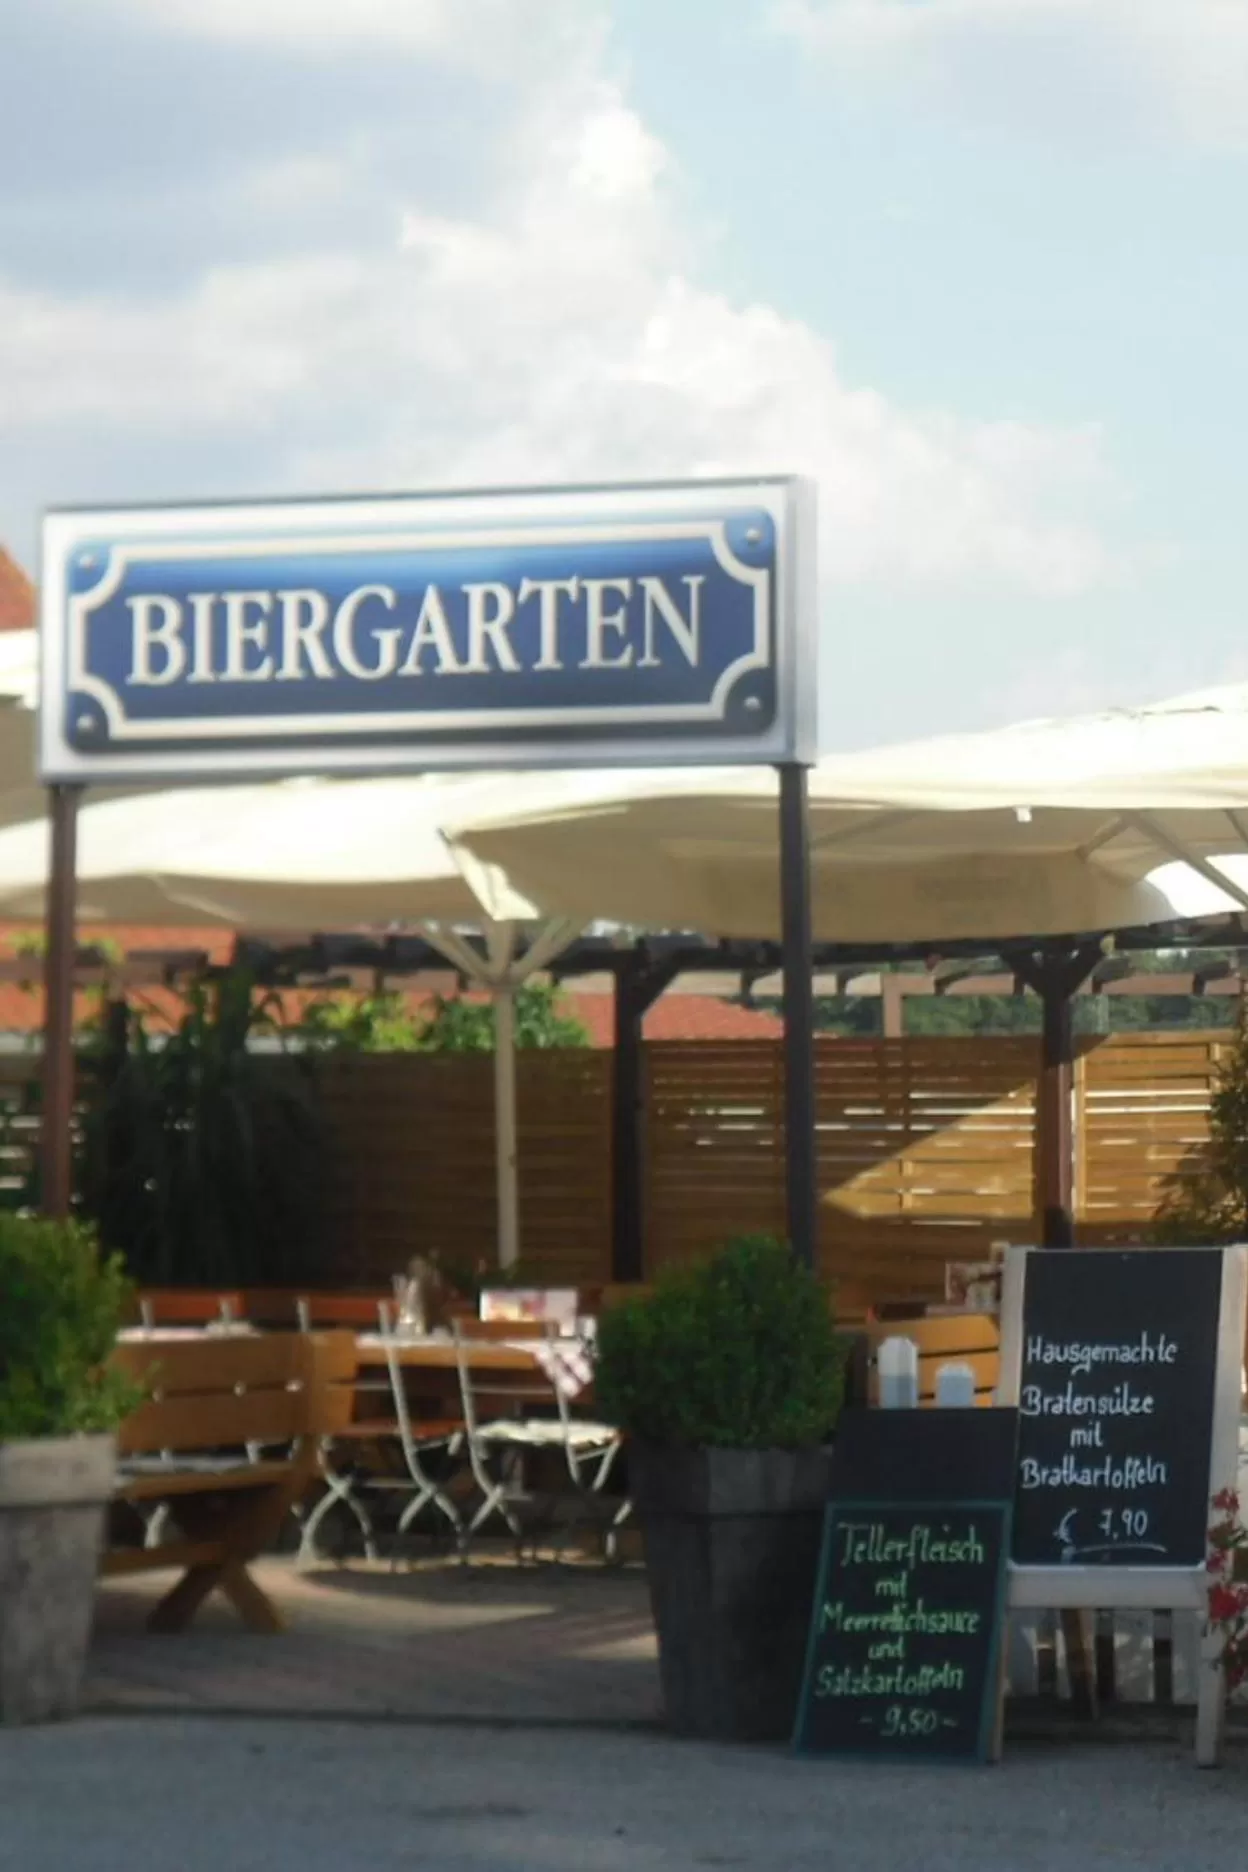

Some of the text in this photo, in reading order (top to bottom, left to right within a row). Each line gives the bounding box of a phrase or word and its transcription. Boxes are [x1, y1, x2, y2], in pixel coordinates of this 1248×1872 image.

[126, 575, 706, 686] BIERGARTEN
[1027, 1330, 1178, 1376] Hausgemachte
[1070, 1421, 1103, 1447] mit
[1020, 1456, 1167, 1489] Bratkartoffeln
[838, 1521, 984, 1570] Tellerfleisch
[875, 1571, 907, 1598] mit
[868, 1636, 905, 1660] und
